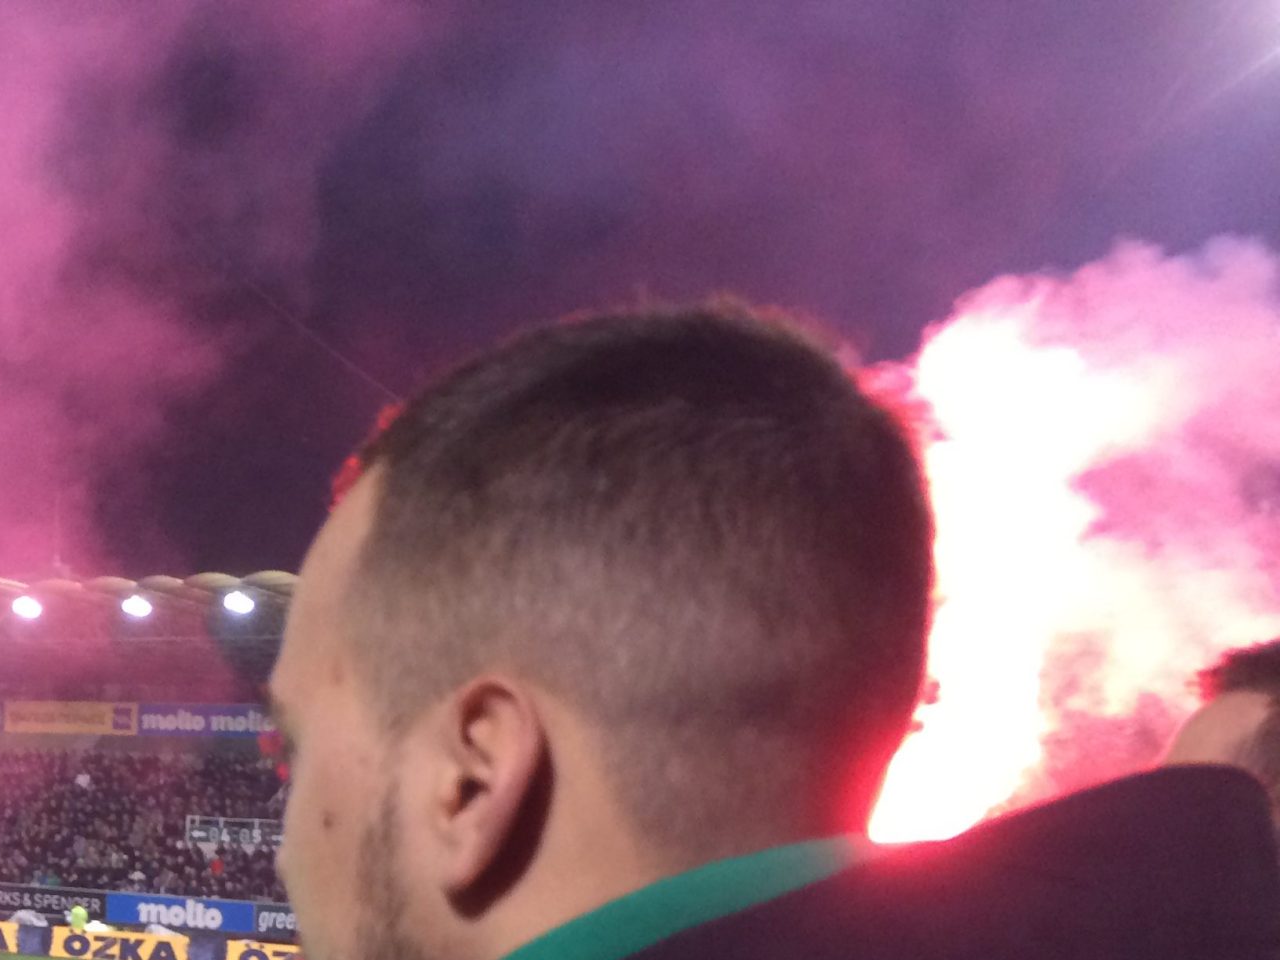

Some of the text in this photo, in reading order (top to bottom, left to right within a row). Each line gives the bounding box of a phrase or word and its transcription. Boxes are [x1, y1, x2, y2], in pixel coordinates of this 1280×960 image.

[141, 708, 205, 731] molto
[33, 893, 101, 913] SPENCER
[137, 899, 223, 929] molto
[258, 911, 299, 932] gree
